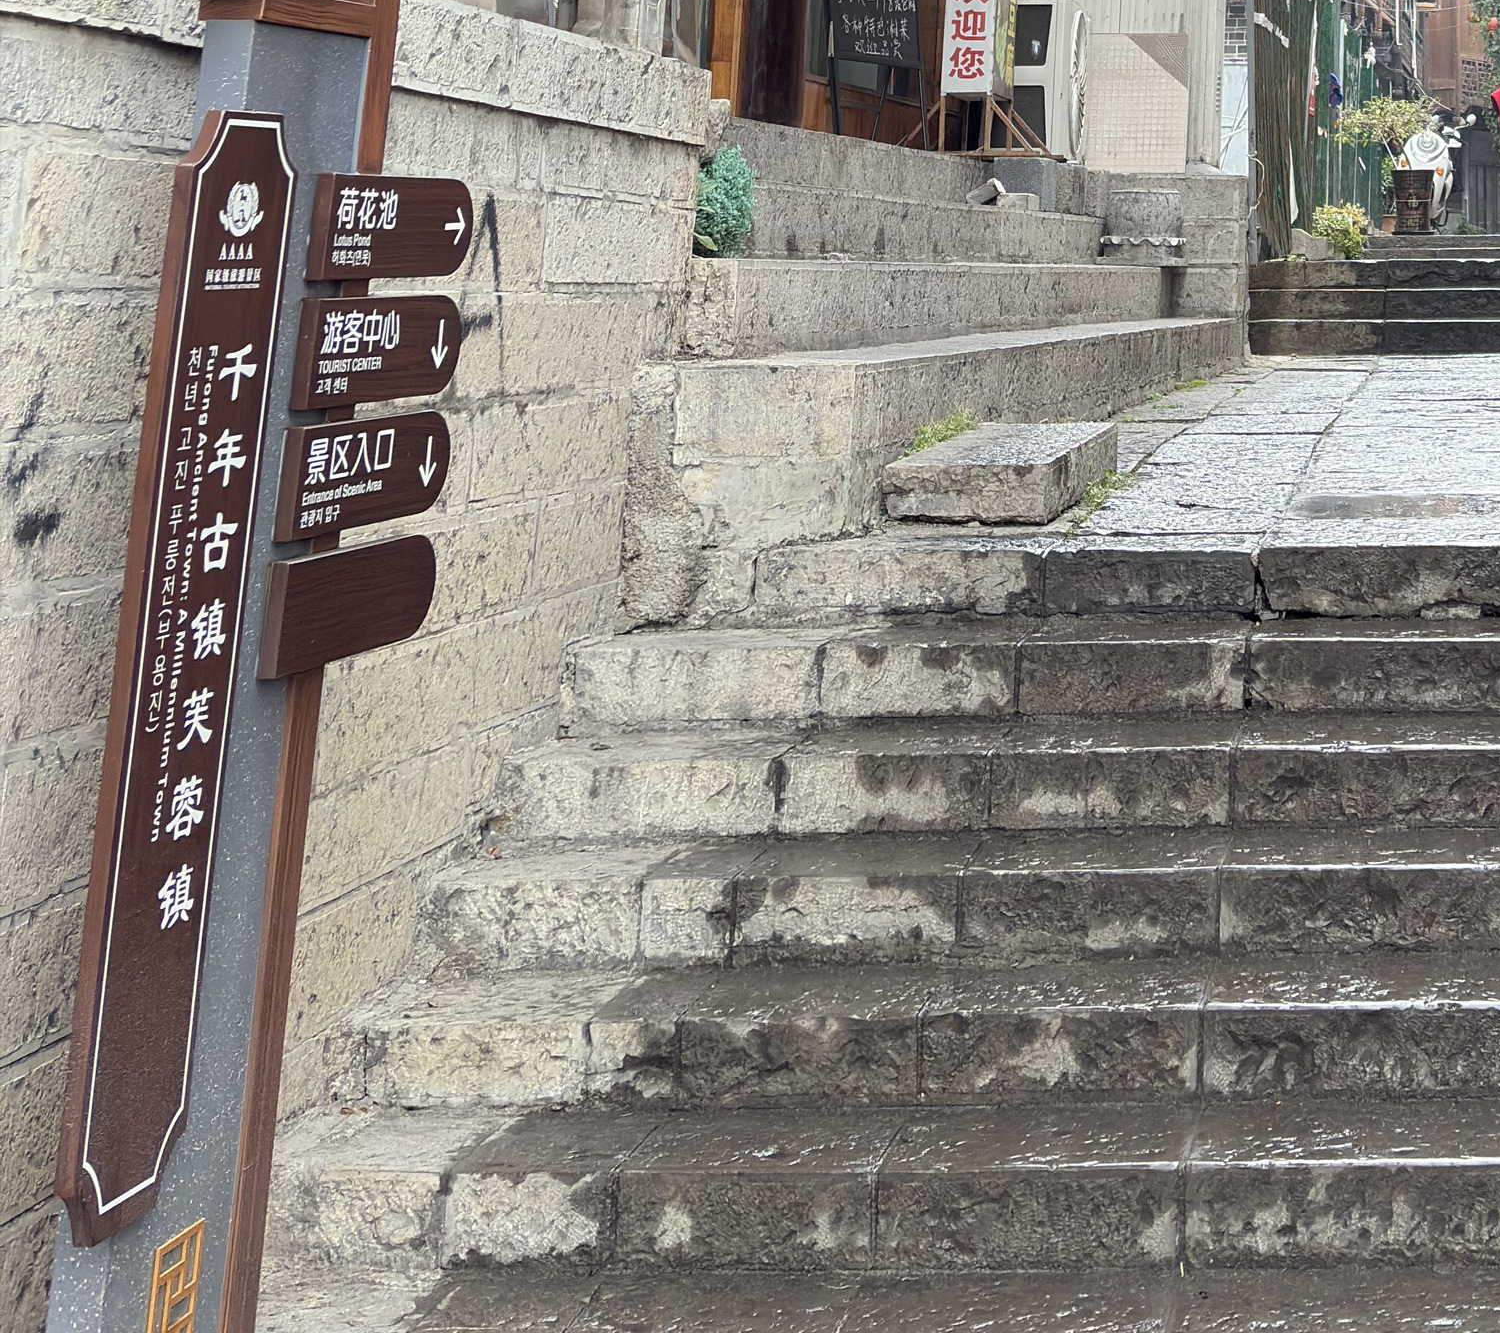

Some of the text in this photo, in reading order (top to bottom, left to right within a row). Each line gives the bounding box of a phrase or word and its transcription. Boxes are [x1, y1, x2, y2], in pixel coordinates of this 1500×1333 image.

[336, 187, 399, 230] 荷花池
[218, 242, 254, 261] AAAA
[333, 233, 372, 247] Lotus Pond
[320, 309, 401, 355] 游客中心
[198, 345, 219, 425] Furong
[315, 376, 348, 394] 고객 센터
[318, 356, 383, 375] TOURIST CENTER
[188, 432, 208, 521] Ancient
[304, 428, 396, 486] 景区入口
[301, 486, 334, 507] Entrance
[334, 486, 342, 501] of
[366, 479, 383, 493] Area
[300, 504, 341, 529] 관광지 입구
[158, 343, 257, 930] 千年古镇芙蓉镇
[177, 608, 188, 625] A
[159, 631, 190, 769] Millennium
[150, 772, 168, 844] Town
